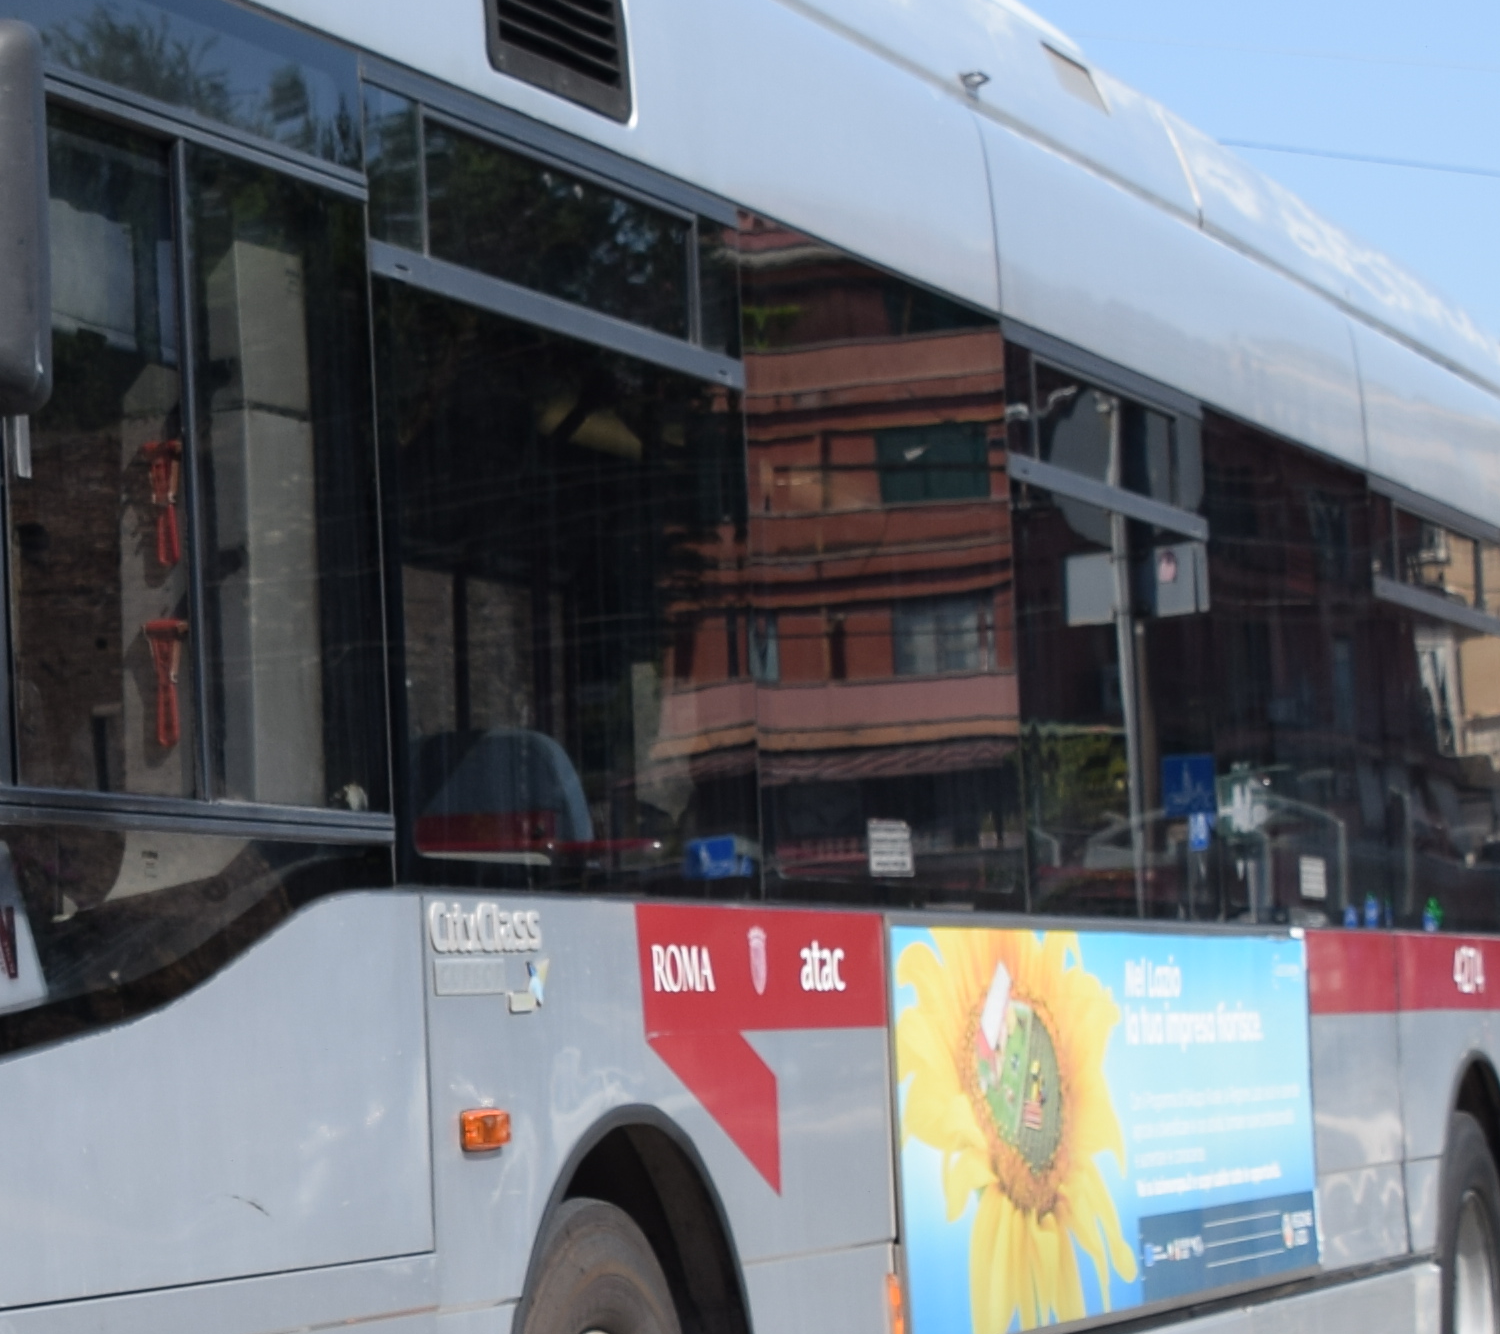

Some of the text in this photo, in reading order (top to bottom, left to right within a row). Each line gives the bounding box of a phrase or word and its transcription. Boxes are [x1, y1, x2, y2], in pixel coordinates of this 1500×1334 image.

[429, 901, 543, 954] CityClass
[651, 939, 847, 993] ROMA atac
[1452, 946, 1486, 995] 4274
